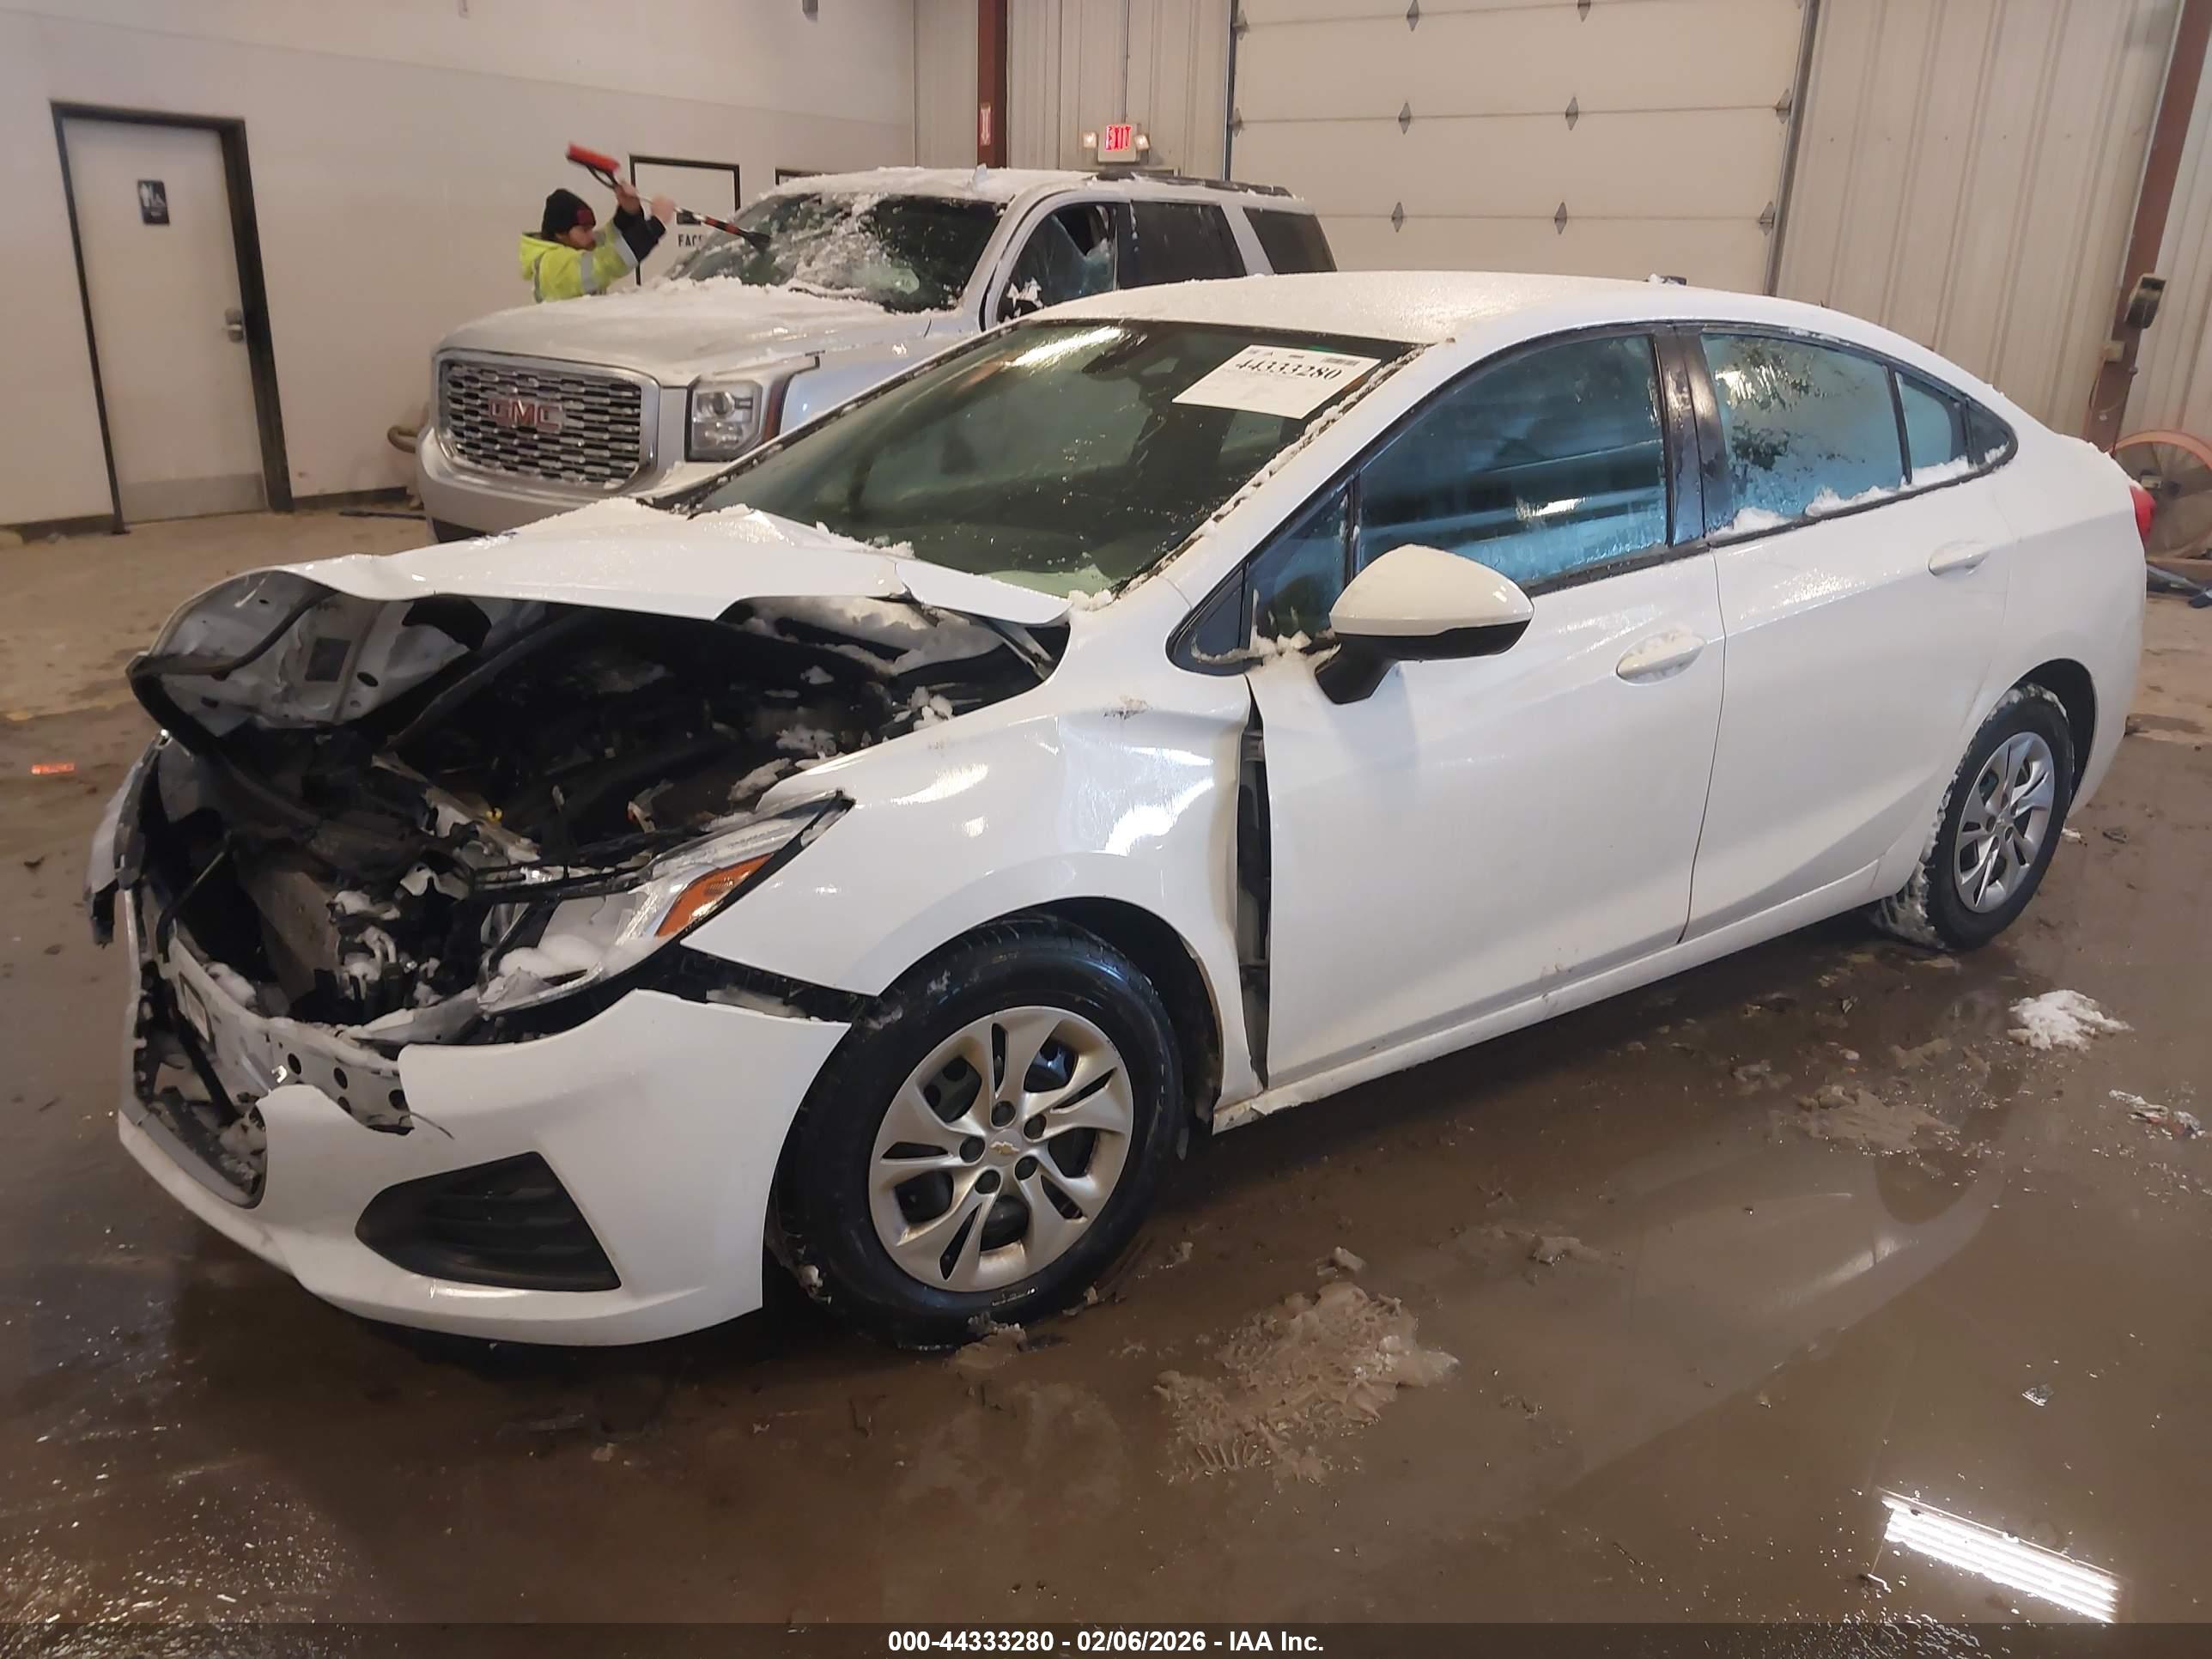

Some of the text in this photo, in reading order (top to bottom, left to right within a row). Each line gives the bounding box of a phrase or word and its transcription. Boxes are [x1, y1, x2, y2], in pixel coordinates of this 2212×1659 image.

[1105, 125, 1132, 151] EXIT
[1236, 359, 1343, 380] 44333280
[489, 398, 563, 434] GMC
